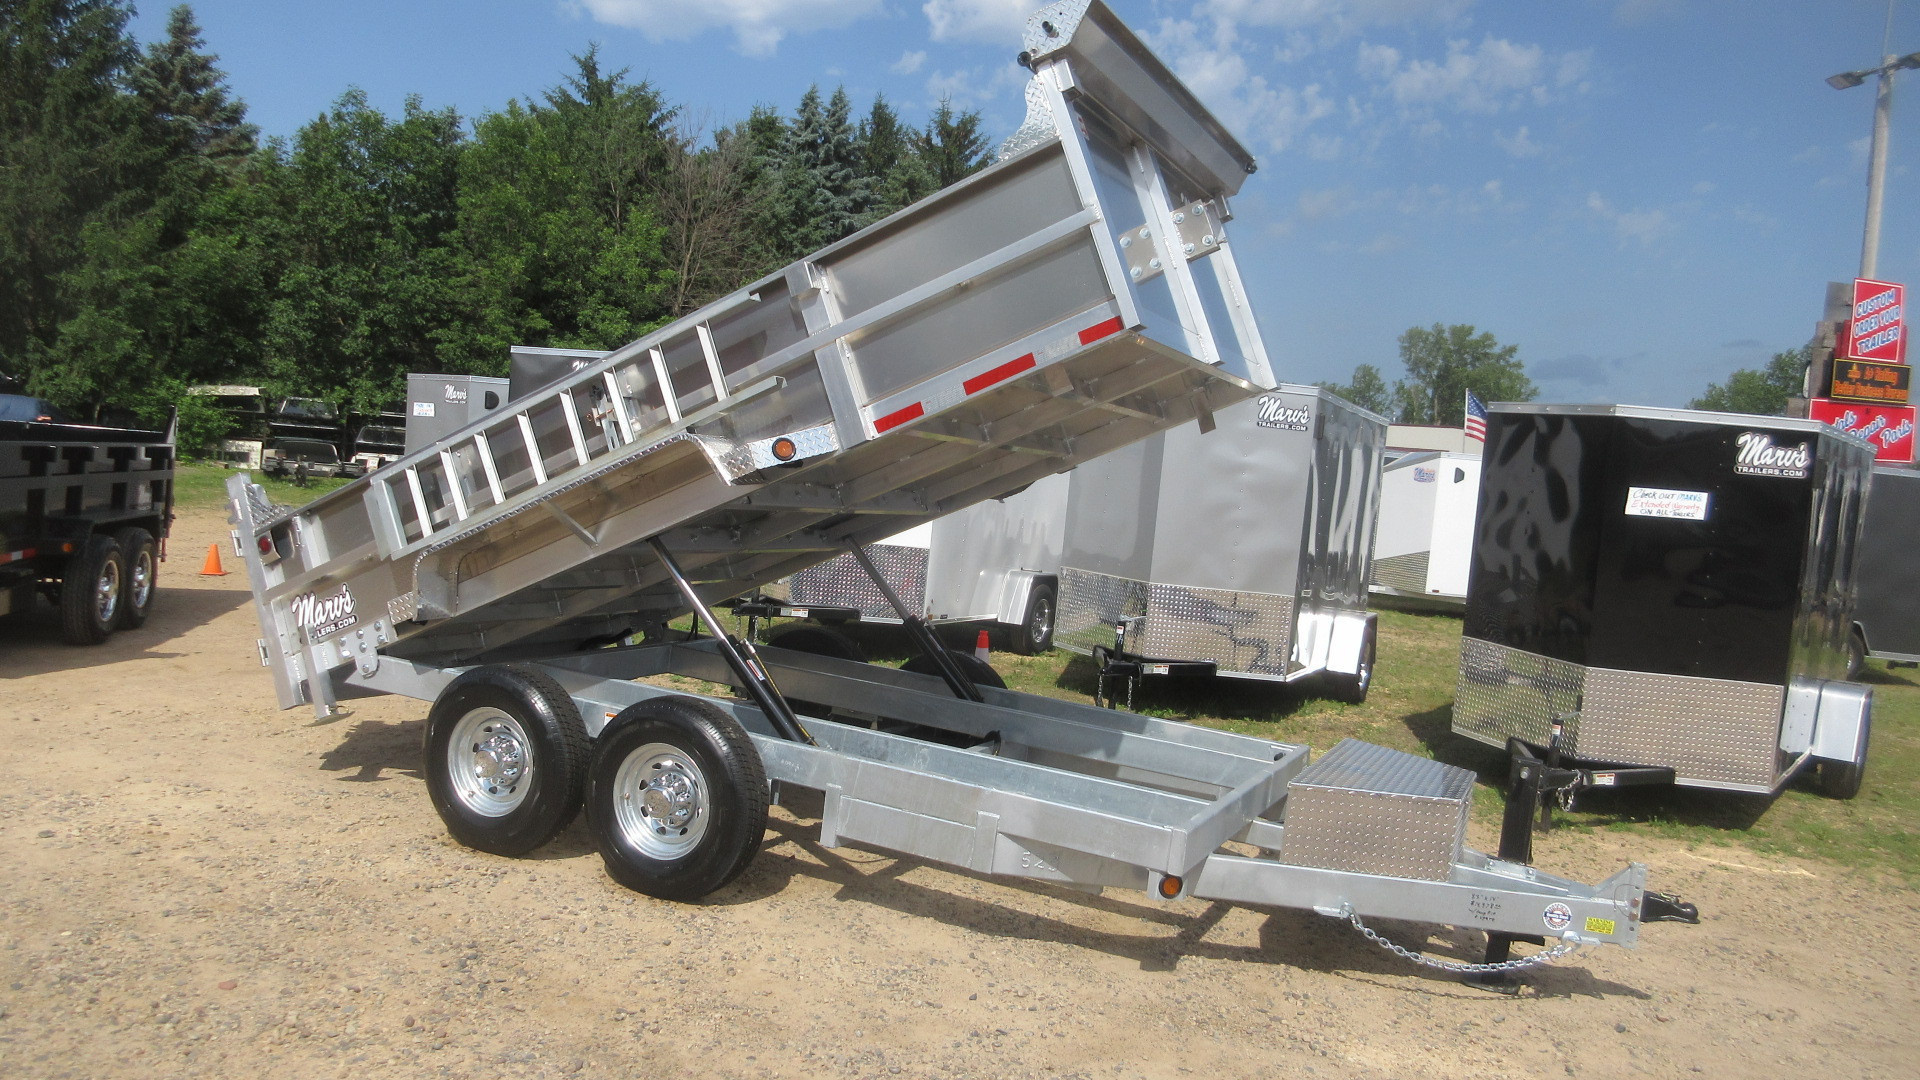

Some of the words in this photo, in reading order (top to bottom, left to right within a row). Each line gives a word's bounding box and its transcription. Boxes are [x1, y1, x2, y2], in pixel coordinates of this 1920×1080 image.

[1855, 288, 1896, 318] CUSTOM
[1853, 313, 1880, 338] ORDER
[1879, 305, 1900, 326] YOUR
[1857, 326, 1899, 355] TRAILER
[1834, 380, 1855, 395] Better
[1855, 382, 1884, 398] Business
[1874, 367, 1898, 385] Rating
[1258, 396, 1310, 424] Marv's
[1258, 421, 1307, 431] TRAILERS.COM
[1880, 419, 1912, 448] Parts
[1738, 434, 1808, 468] Marv's
[1737, 466, 1803, 477] TRAILERS.COM
[1630, 500, 1671, 509] Extended
[292, 583, 355, 627] Marv's
[314, 615, 356, 638] LERS.COM
